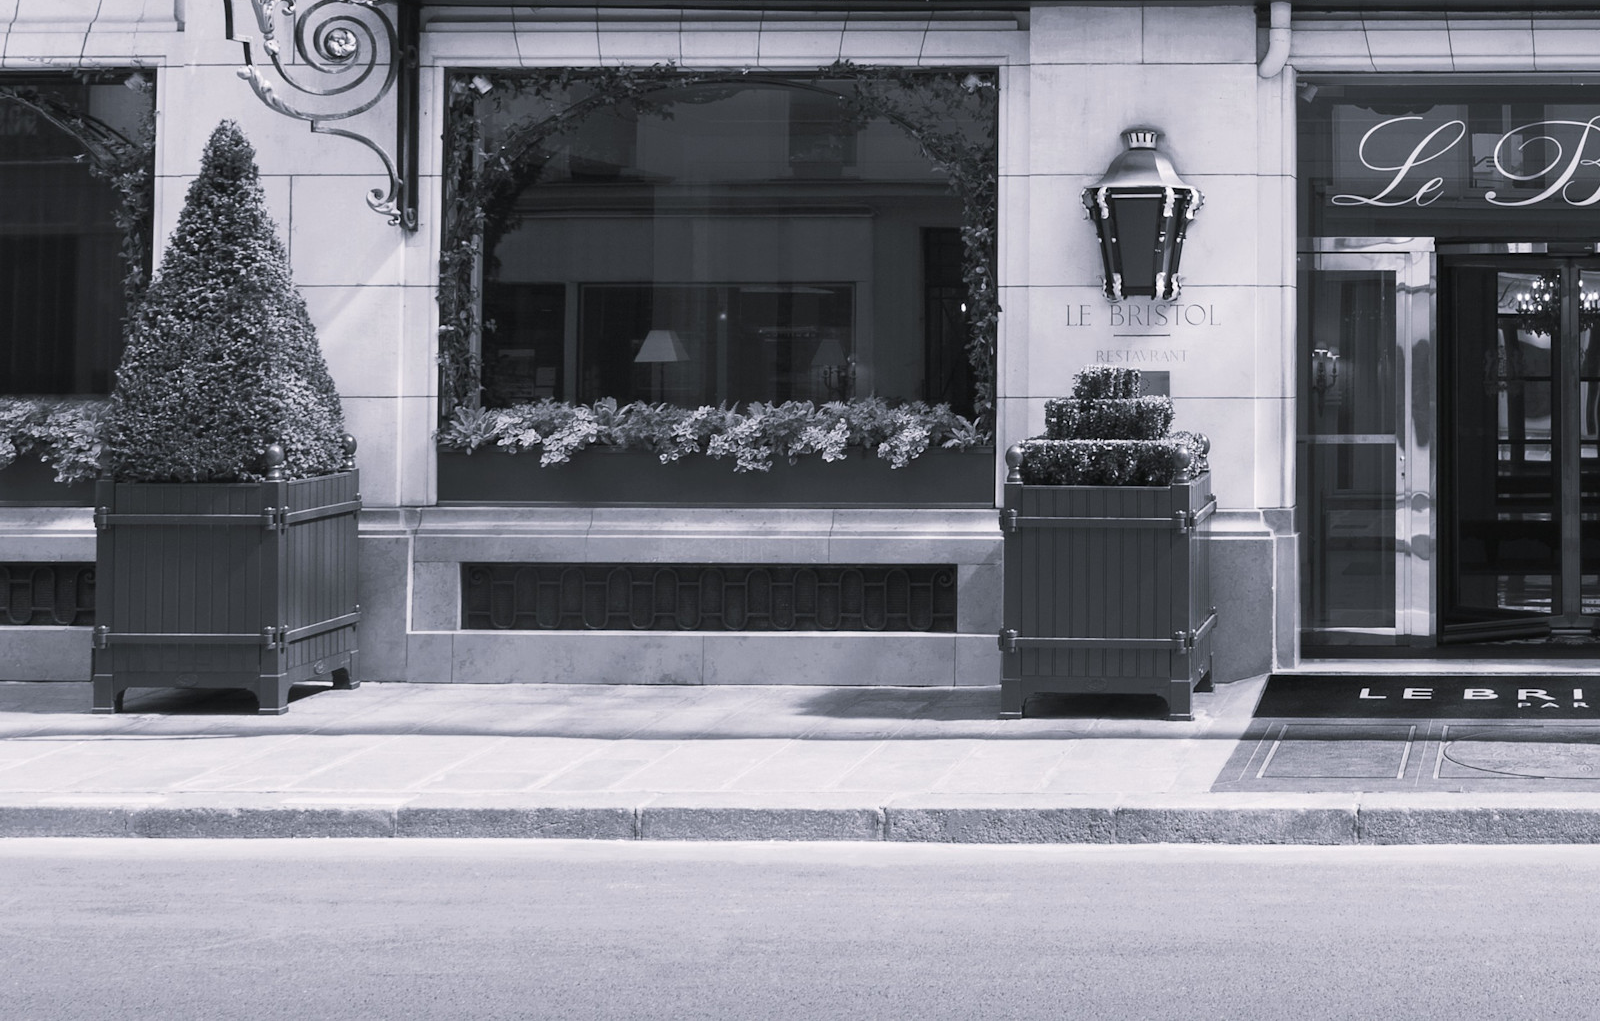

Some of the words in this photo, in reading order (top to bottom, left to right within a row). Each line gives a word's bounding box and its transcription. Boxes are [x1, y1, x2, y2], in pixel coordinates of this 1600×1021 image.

[1331, 116, 1466, 206] Le
[1066, 304, 1091, 326] LE
[1110, 304, 1221, 326] BRISTOL
[1359, 687, 1434, 700] LE
